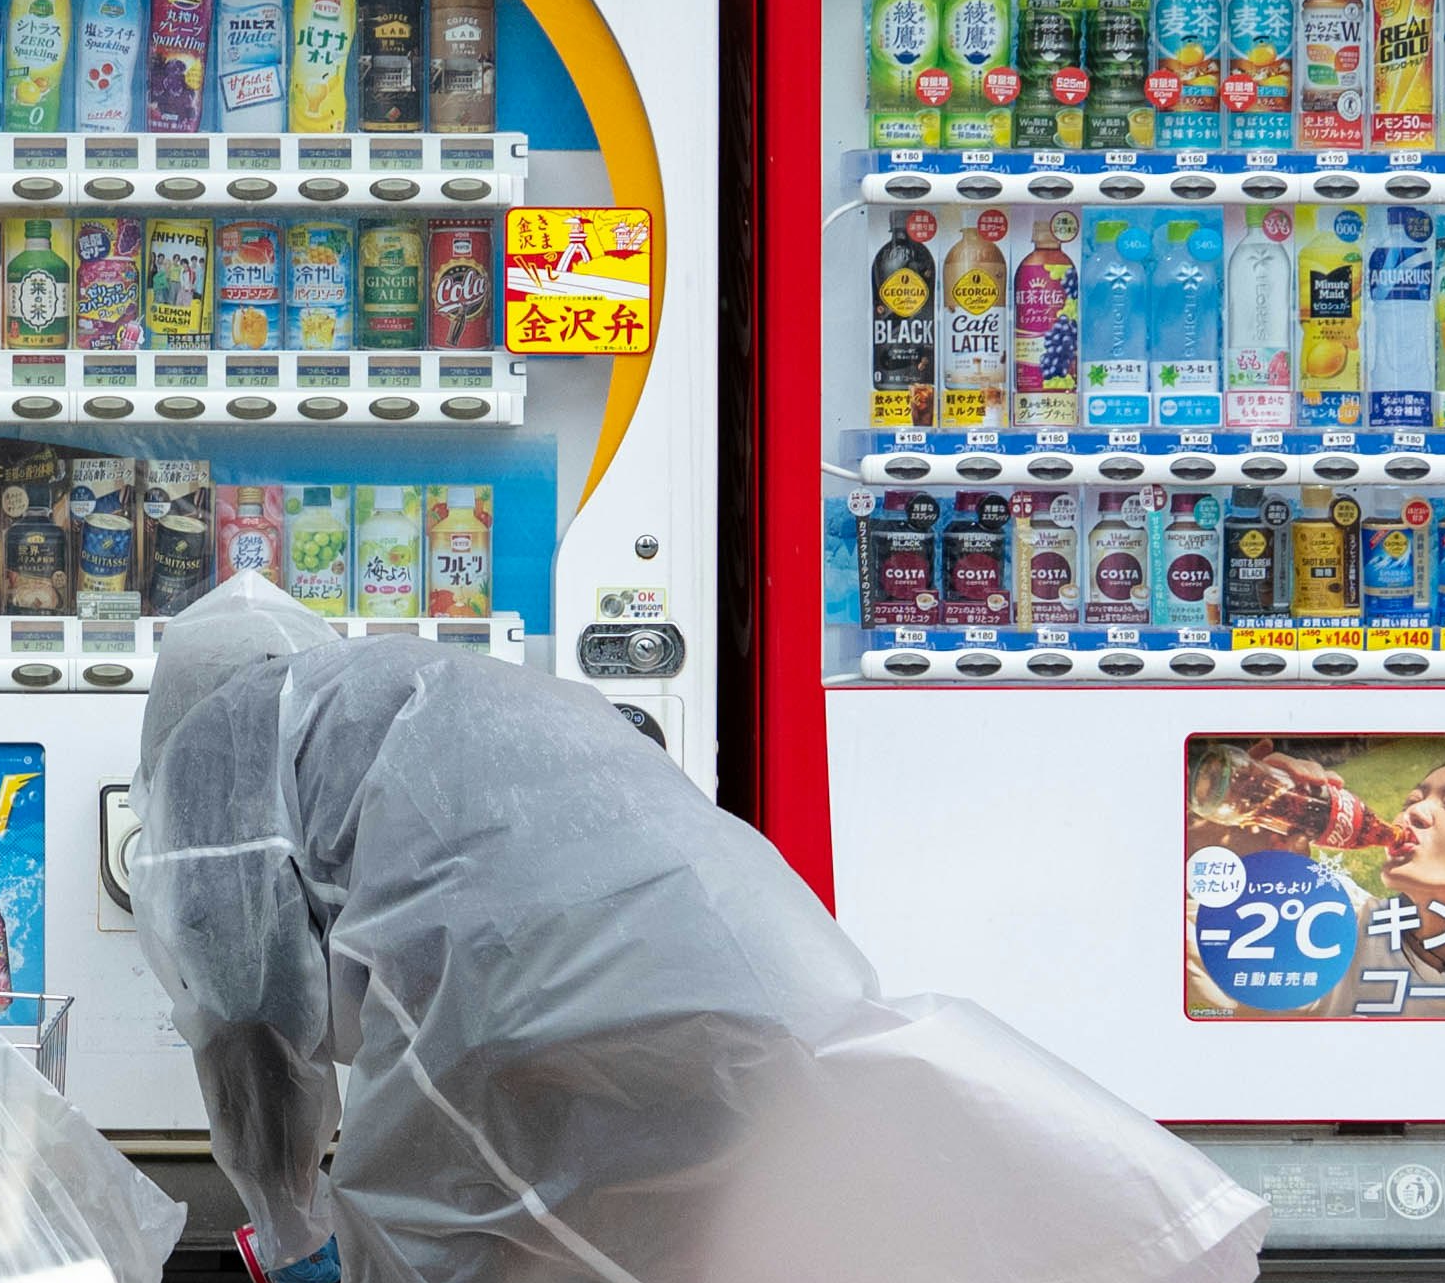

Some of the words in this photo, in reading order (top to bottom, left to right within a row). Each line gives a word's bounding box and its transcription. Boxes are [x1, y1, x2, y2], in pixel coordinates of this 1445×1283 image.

[16, 20, 62, 38] シトラス
[84, 23, 136, 42] 塩とライチ
[158, 21, 204, 36] グレープ
[230, 20, 276, 31] カルピス
[892, 0, 915, 50] 綾鷹
[962, 0, 989, 50] 綾鷹
[1304, 21, 1339, 37] からだ
[20, 34, 56, 49] ZERO
[151, 32, 206, 51] Sparkling
[227, 30, 277, 46] Water
[297, 30, 348, 51] バナナ
[1380, 24, 1428, 46] REAL
[14, 46, 59, 62] Sparkling
[1380, 43, 1429, 64] GOLD
[919, 76, 949, 88] 容量増
[1056, 78, 1087, 90] 525ml
[151, 234, 208, 248] ENHYPEN
[518, 217, 536, 249] 金沢
[227, 267, 275, 285] 冷やし
[295, 267, 344, 285] 冷やし
[366, 276, 416, 288] GINGER
[1370, 268, 1432, 286] AQUARIUS
[437, 276, 488, 304] Cola
[954, 287, 998, 298] GEORGIA
[1314, 279, 1349, 290] Minute
[29, 278, 47, 321] 葉の茶
[78, 287, 138, 313] スパークリング
[378, 288, 405, 301] ALE
[883, 288, 926, 298] GEORGIA
[1016, 289, 1065, 305] 紅茶花伝
[1320, 289, 1346, 300] Maid
[158, 306, 192, 316] LEMON
[150, 315, 191, 326] SQUASH
[516, 303, 644, 344] 金沢弁
[952, 314, 999, 335] Café
[952, 335, 1000, 353] LATTE
[946, 394, 986, 405] 軽やかな
[948, 406, 986, 417] ミルク感
[232, 556, 270, 570] ネクター
[437, 555, 482, 574] フルーツ
[886, 567, 926, 581] COSTA
[957, 568, 997, 582] COSTA
[1100, 568, 1139, 582] COSTA
[290, 584, 344, 600] 白ぶどう
[1236, 619, 1294, 628] お買い得価格
[1192, 862, 1236, 876] 夏だけ
[1192, 878, 1240, 893] 冷たい!
[1248, 880, 1312, 894] いつもより
[1233, 971, 1318, 987] 自動販売機
